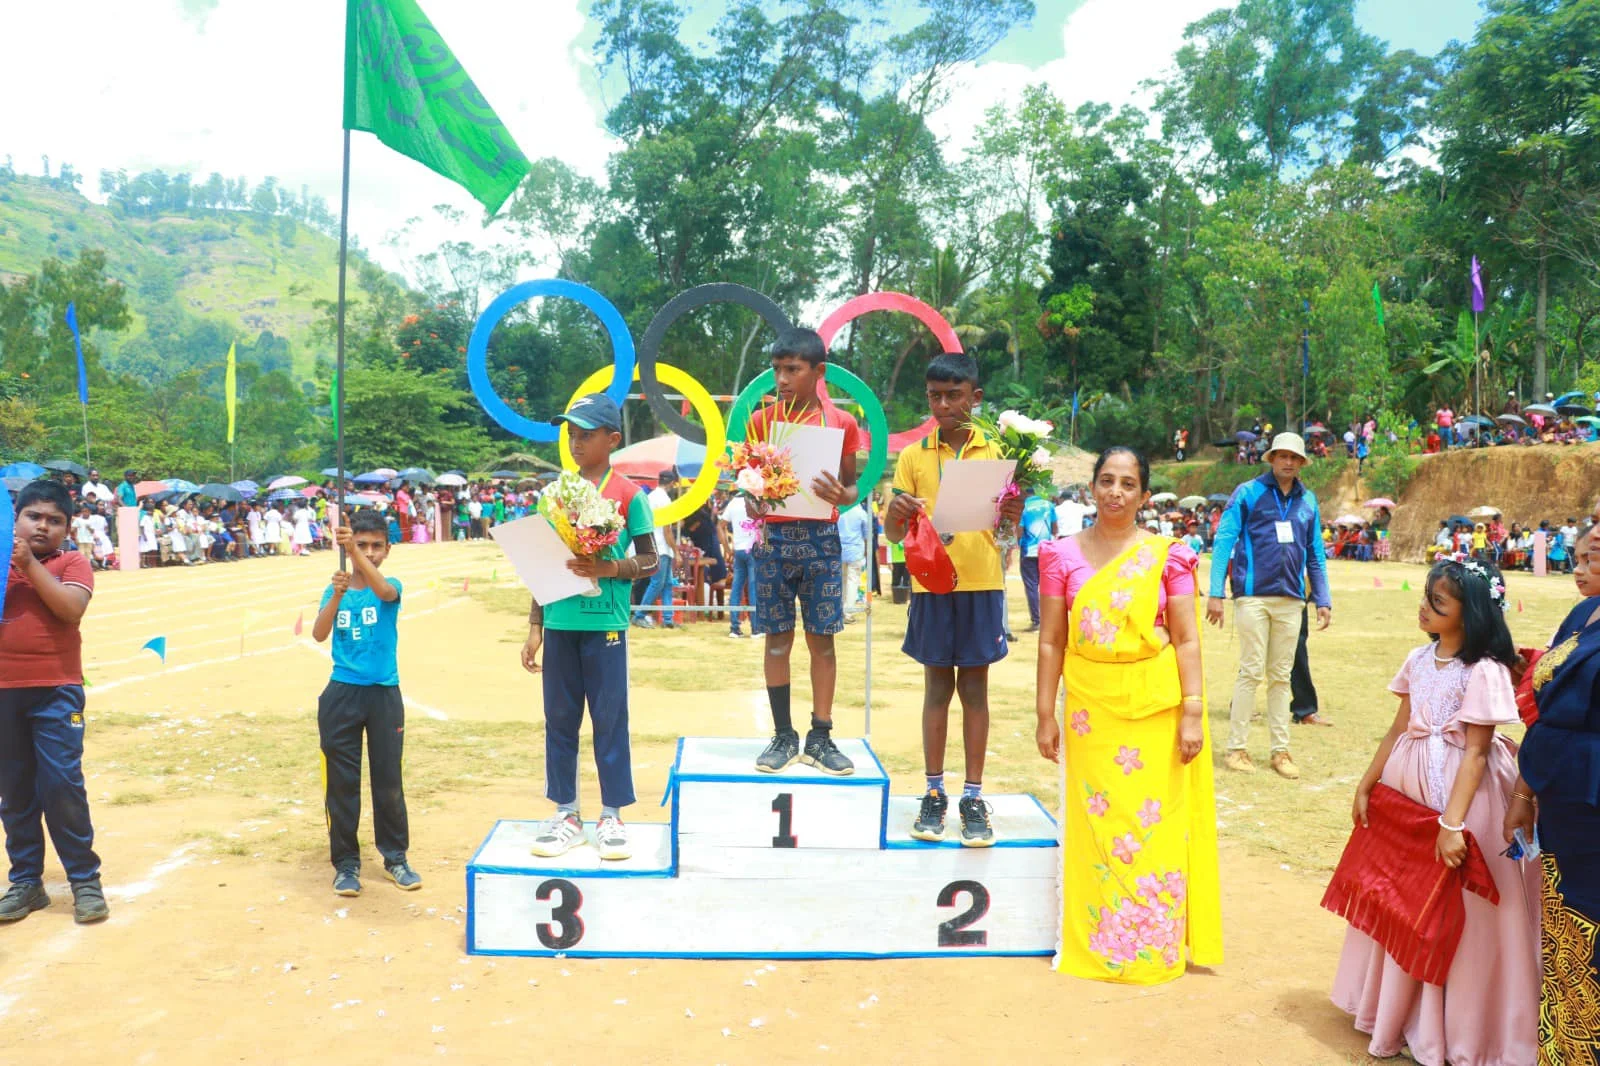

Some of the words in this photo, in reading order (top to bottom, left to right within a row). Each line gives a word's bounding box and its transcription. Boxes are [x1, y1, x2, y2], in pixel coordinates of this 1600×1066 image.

[338, 608, 376, 626] STR
[772, 793, 797, 848] 1
[536, 878, 584, 949] 3
[937, 880, 990, 947] 2
